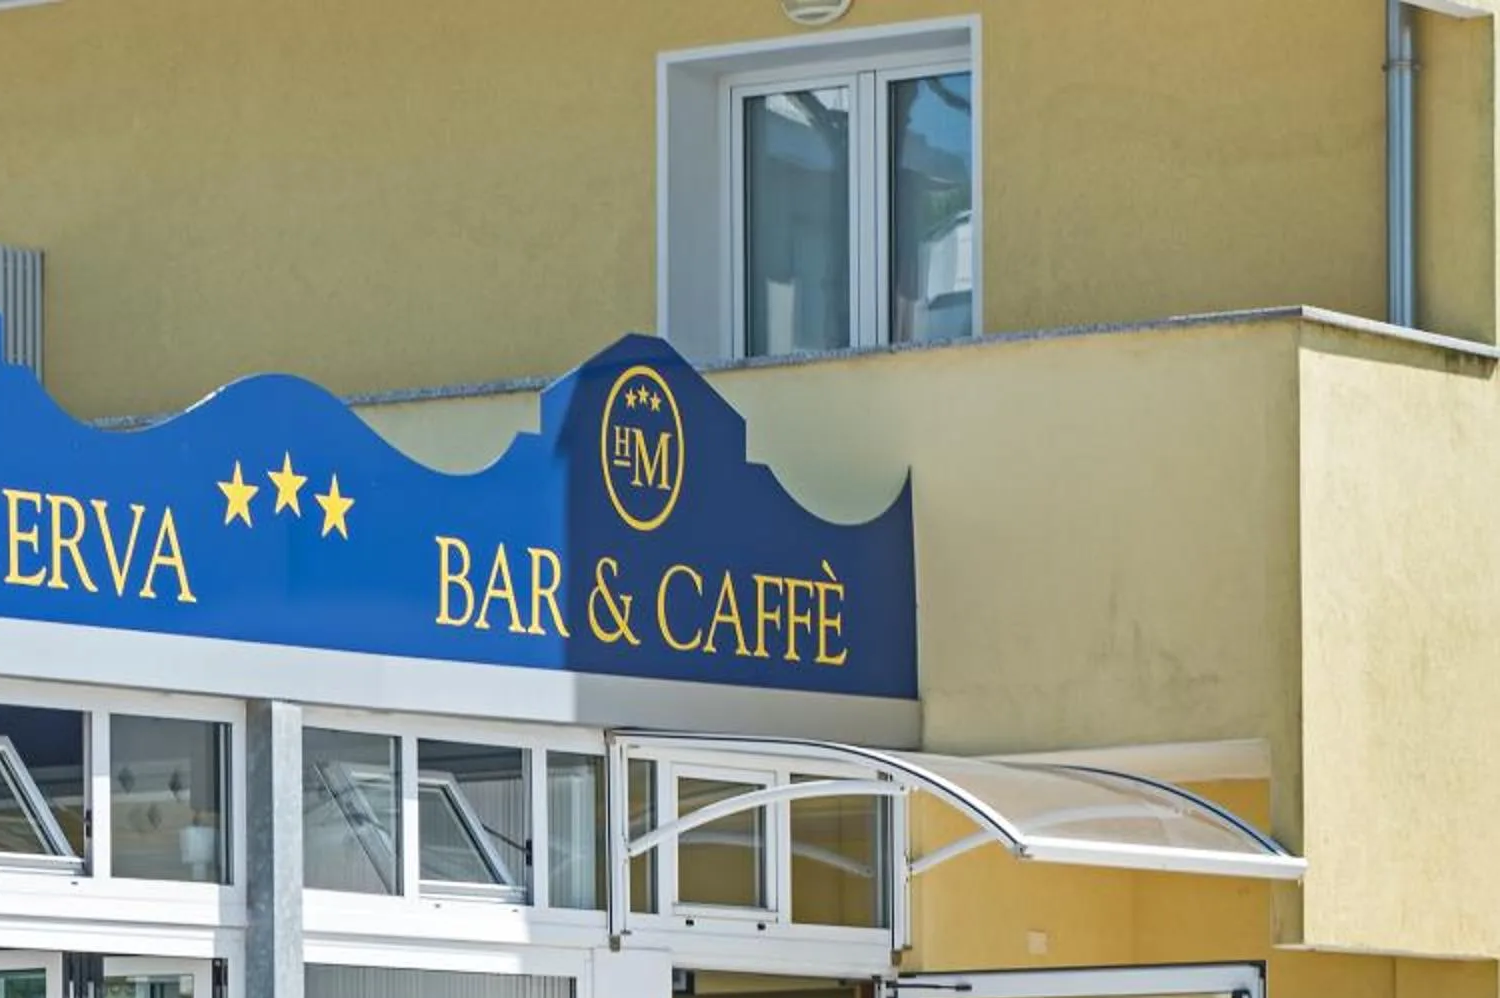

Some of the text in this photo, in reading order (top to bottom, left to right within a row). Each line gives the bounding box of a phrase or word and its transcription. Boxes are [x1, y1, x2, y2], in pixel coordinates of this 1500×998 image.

[435, 535, 849, 667] BAR & CAFFÈ
